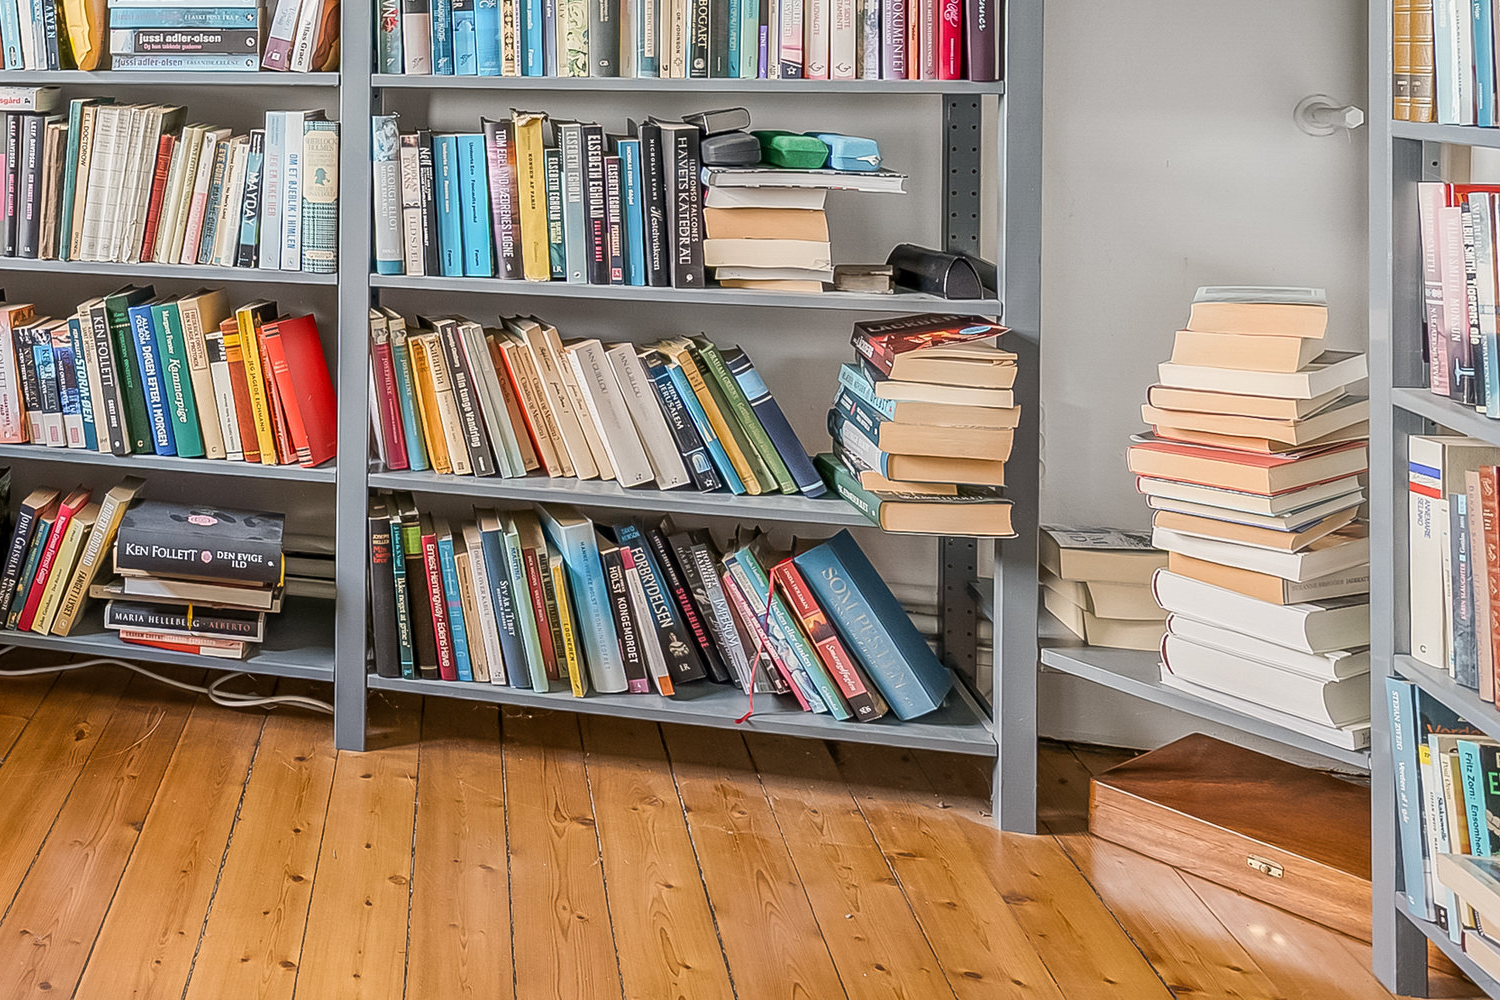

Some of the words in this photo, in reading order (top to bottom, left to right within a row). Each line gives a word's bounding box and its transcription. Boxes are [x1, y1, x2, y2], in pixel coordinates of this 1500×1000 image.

[45, 5, 55, 38] ARVEN
[697, 0, 708, 49] BOGART
[139, 33, 163, 44] jussi
[165, 33, 221, 43] adler-olsen
[289, 154, 298, 165] OM
[419, 148, 432, 166] Nell
[566, 131, 579, 168] ELSEBETH
[678, 137, 689, 190] HAVETS
[288, 168, 298, 177] ET
[387, 165, 397, 202] GEORGE
[403, 157, 411, 189] EVANS
[410, 153, 418, 192] NICHOLAS
[548, 157, 560, 191] ELSEBETH
[568, 172, 581, 203] EGHOLM
[244, 172, 259, 226] MAYDAY
[288, 180, 297, 212] ØJEBLIK
[549, 192, 561, 220] EGHOLM
[389, 204, 397, 232] ELIOT
[679, 192, 691, 264] KATEDRAL
[691, 204, 699, 242] FALCONES
[287, 220, 297, 249] HIMLEN
[650, 206, 663, 270] Hestehviskeren
[1448, 259, 1461, 292] SMITH
[93, 316, 104, 337] KEN
[135, 315, 145, 344] FOLSOM
[142, 317, 150, 341] ALLAN
[1449, 298, 1462, 342] MONSUN
[98, 341, 113, 387] FOLLETT
[141, 346, 155, 376] DAGEN
[247, 360, 255, 372] JEG
[429, 340, 444, 385] Katarina
[586, 348, 595, 363] JAN
[147, 377, 160, 403] EFTER
[250, 373, 259, 396] JAGEDE
[381, 358, 392, 395] JOSEPHINE
[401, 359, 412, 396] JOSEPHINE
[455, 372, 467, 388] Min
[590, 363, 607, 394] GUILLOU
[618, 351, 628, 367] JAN
[624, 367, 641, 398] GUILLOU
[255, 398, 266, 432] EICHMANN
[458, 388, 470, 412] tunge
[658, 383, 684, 430] JERUSALEM
[152, 409, 168, 446] MORGEN
[463, 412, 480, 447] Vandring
[18, 512, 32, 535] JOHN
[96, 502, 114, 531] ROBERT
[1417, 497, 1425, 527] SELINKO
[6, 537, 25, 576] GRISHAM
[82, 532, 103, 566] GODDARD
[126, 543, 149, 557] KEN
[152, 545, 197, 562] FOLLETT
[217, 550, 235, 560] DEN
[238, 552, 262, 563] EVIGE
[231, 560, 247, 568] ILD
[426, 543, 438, 570] Ernest
[71, 570, 87, 595] FANGET
[429, 571, 443, 618] Hemingway
[609, 566, 622, 594] HOLST
[630, 546, 673, 628] FORBRYDELSEN
[63, 599, 76, 618] LYSET
[675, 587, 709, 649] SVINEHUNDE
[712, 597, 739, 647] IMPERIUM
[436, 622, 448, 646] Edens
[616, 596, 638, 664] KONGEMORDET
[821, 566, 858, 607] SOM
[855, 612, 909, 690] PESTEN
[441, 646, 451, 667] Have
[1392, 690, 1401, 721] STEFAN
[1394, 722, 1403, 750] ZWEIG
[1398, 762, 1407, 790] Verden
[1400, 791, 1408, 802] af
